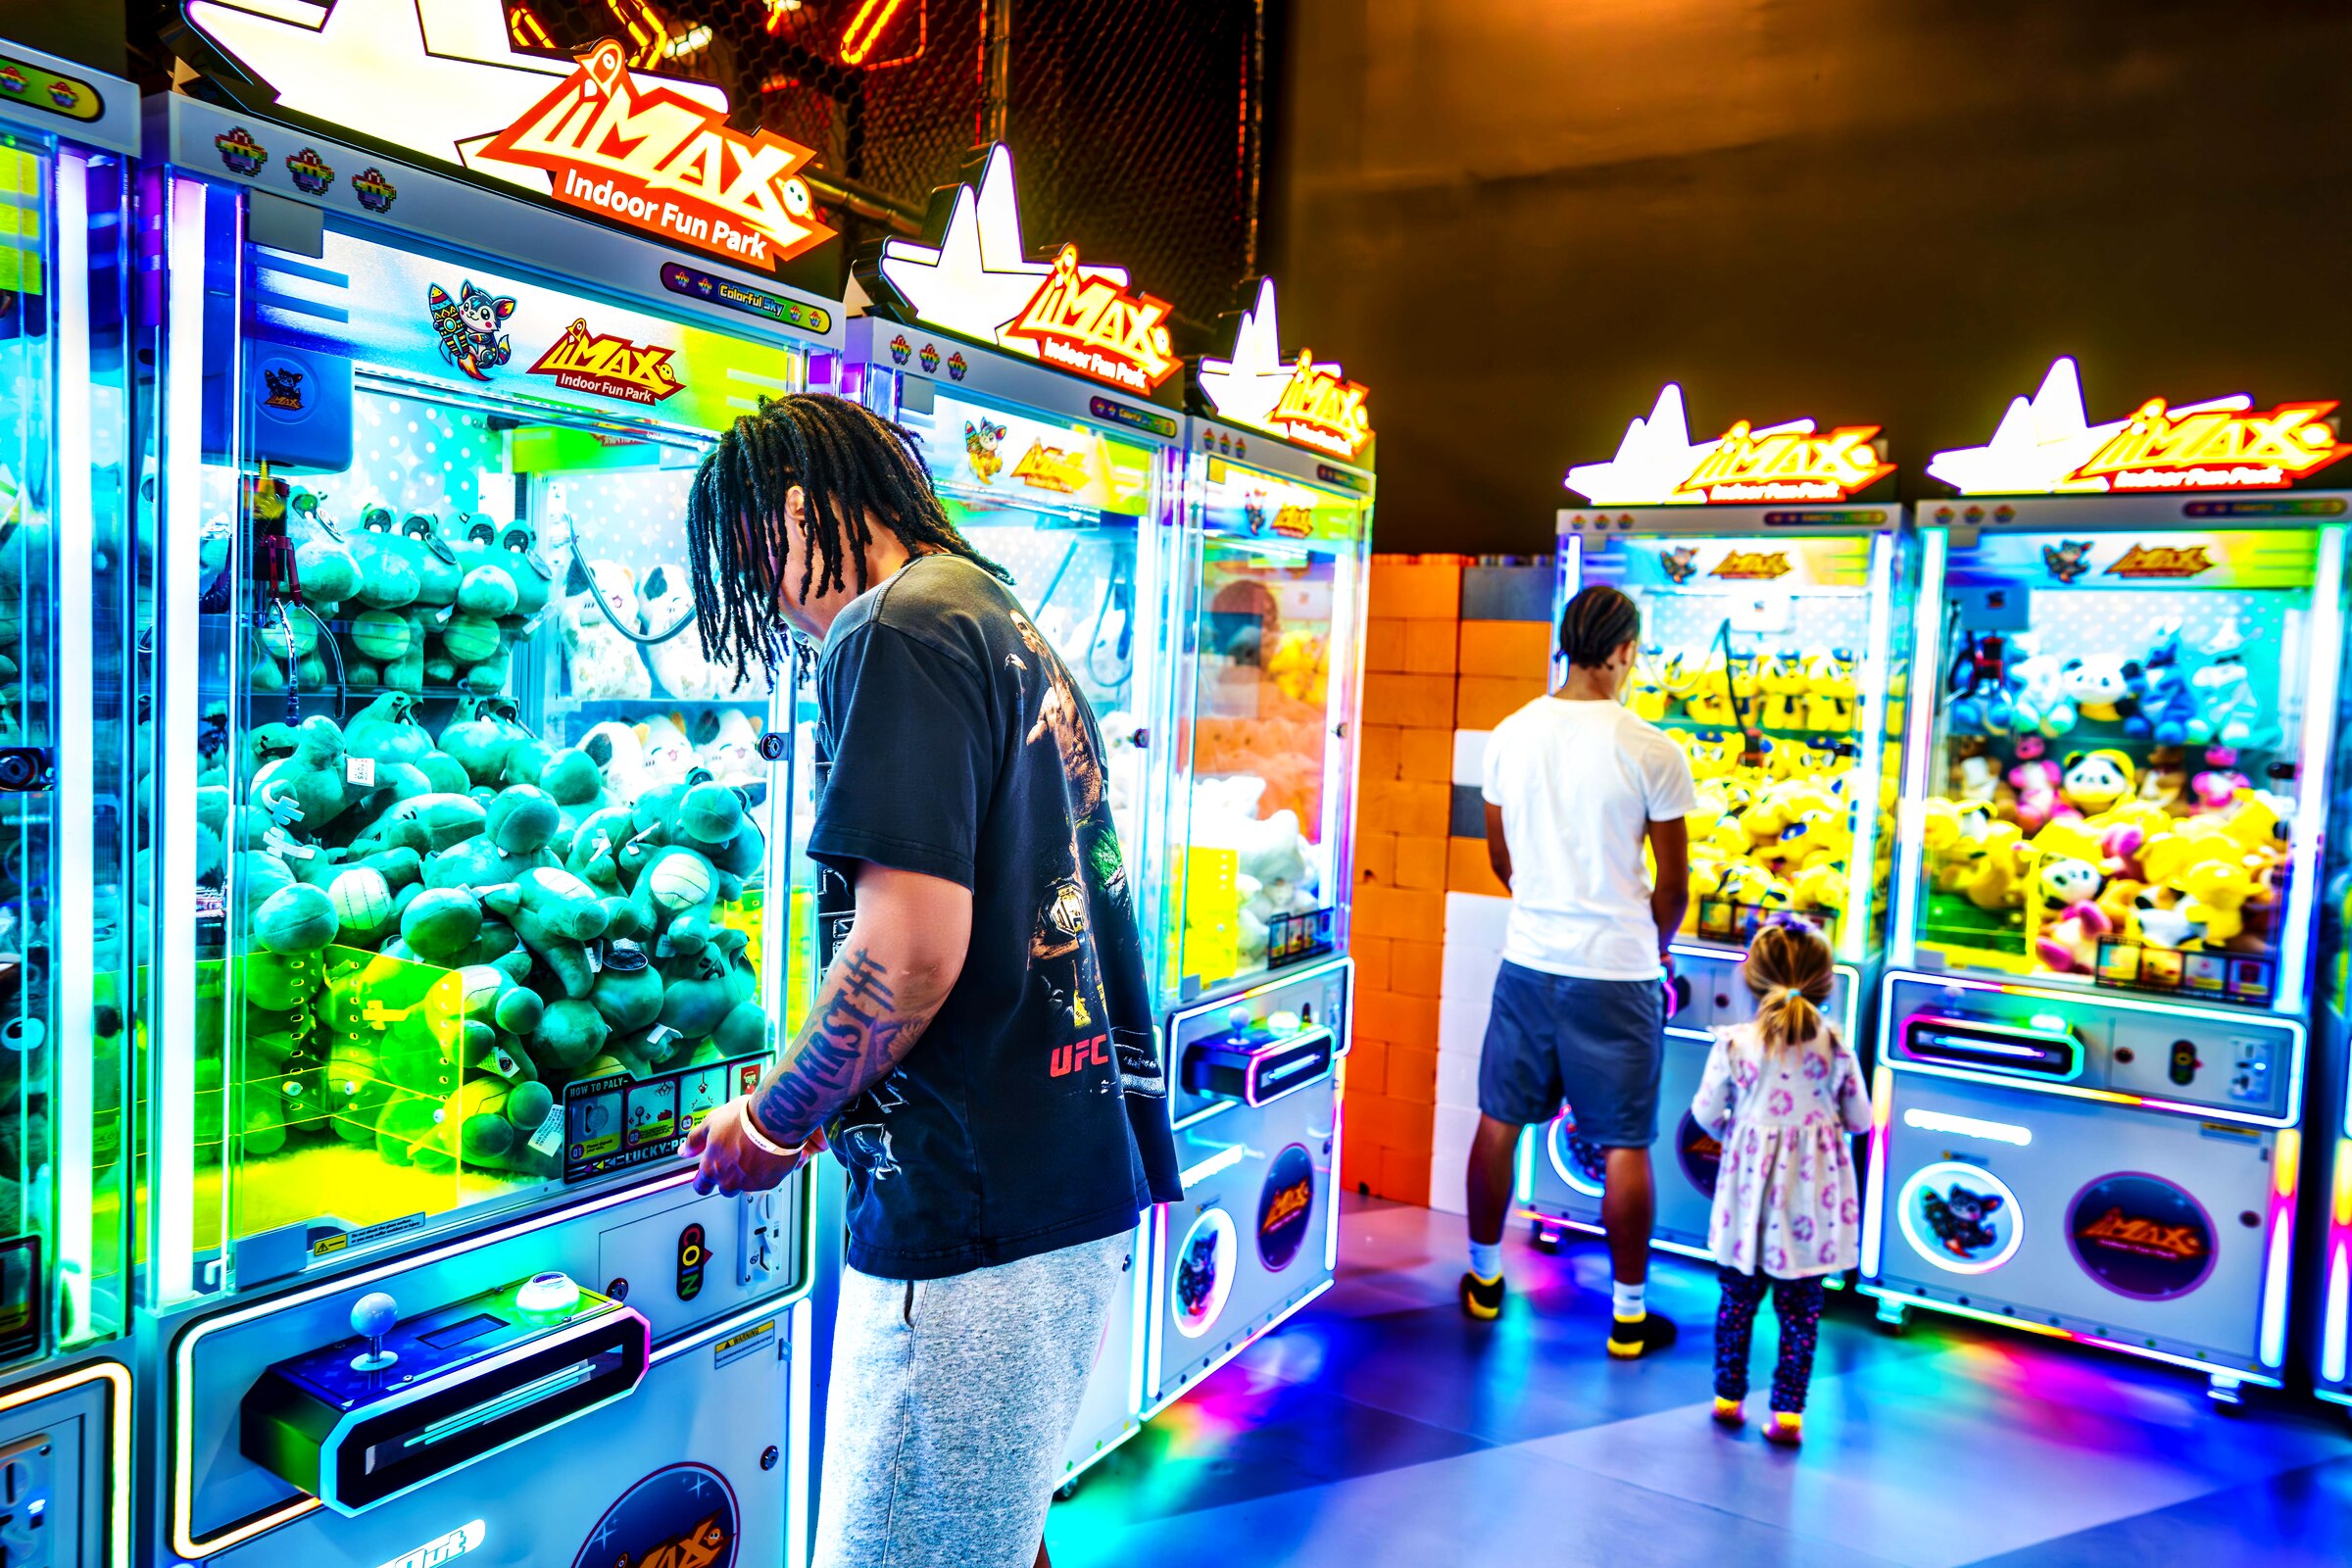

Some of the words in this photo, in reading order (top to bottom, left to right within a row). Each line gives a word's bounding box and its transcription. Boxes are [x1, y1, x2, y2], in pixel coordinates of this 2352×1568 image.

[564, 169, 660, 222] Indoor
[661, 203, 710, 241] Fun
[711, 220, 767, 261] Park
[718, 283, 762, 309] Colorful
[762, 298, 785, 318] Sky
[1045, 337, 1091, 369] Indoor
[1092, 353, 1117, 378] Fun
[1115, 362, 1147, 389] Park
[560, 373, 601, 394] Indoor
[602, 380, 623, 397] Fun
[624, 385, 652, 403] Park
[795, 989, 877, 1091] FIRST
[1051, 1035, 1108, 1078] UFC
[569, 1084, 590, 1098] HOW
[591, 1081, 603, 1094] TO
[572, 1147, 584, 1160] 01
[625, 1143, 666, 1164] LUCKY
[629, 1132, 640, 1143] 02
[682, 1227, 702, 1296] COIN
